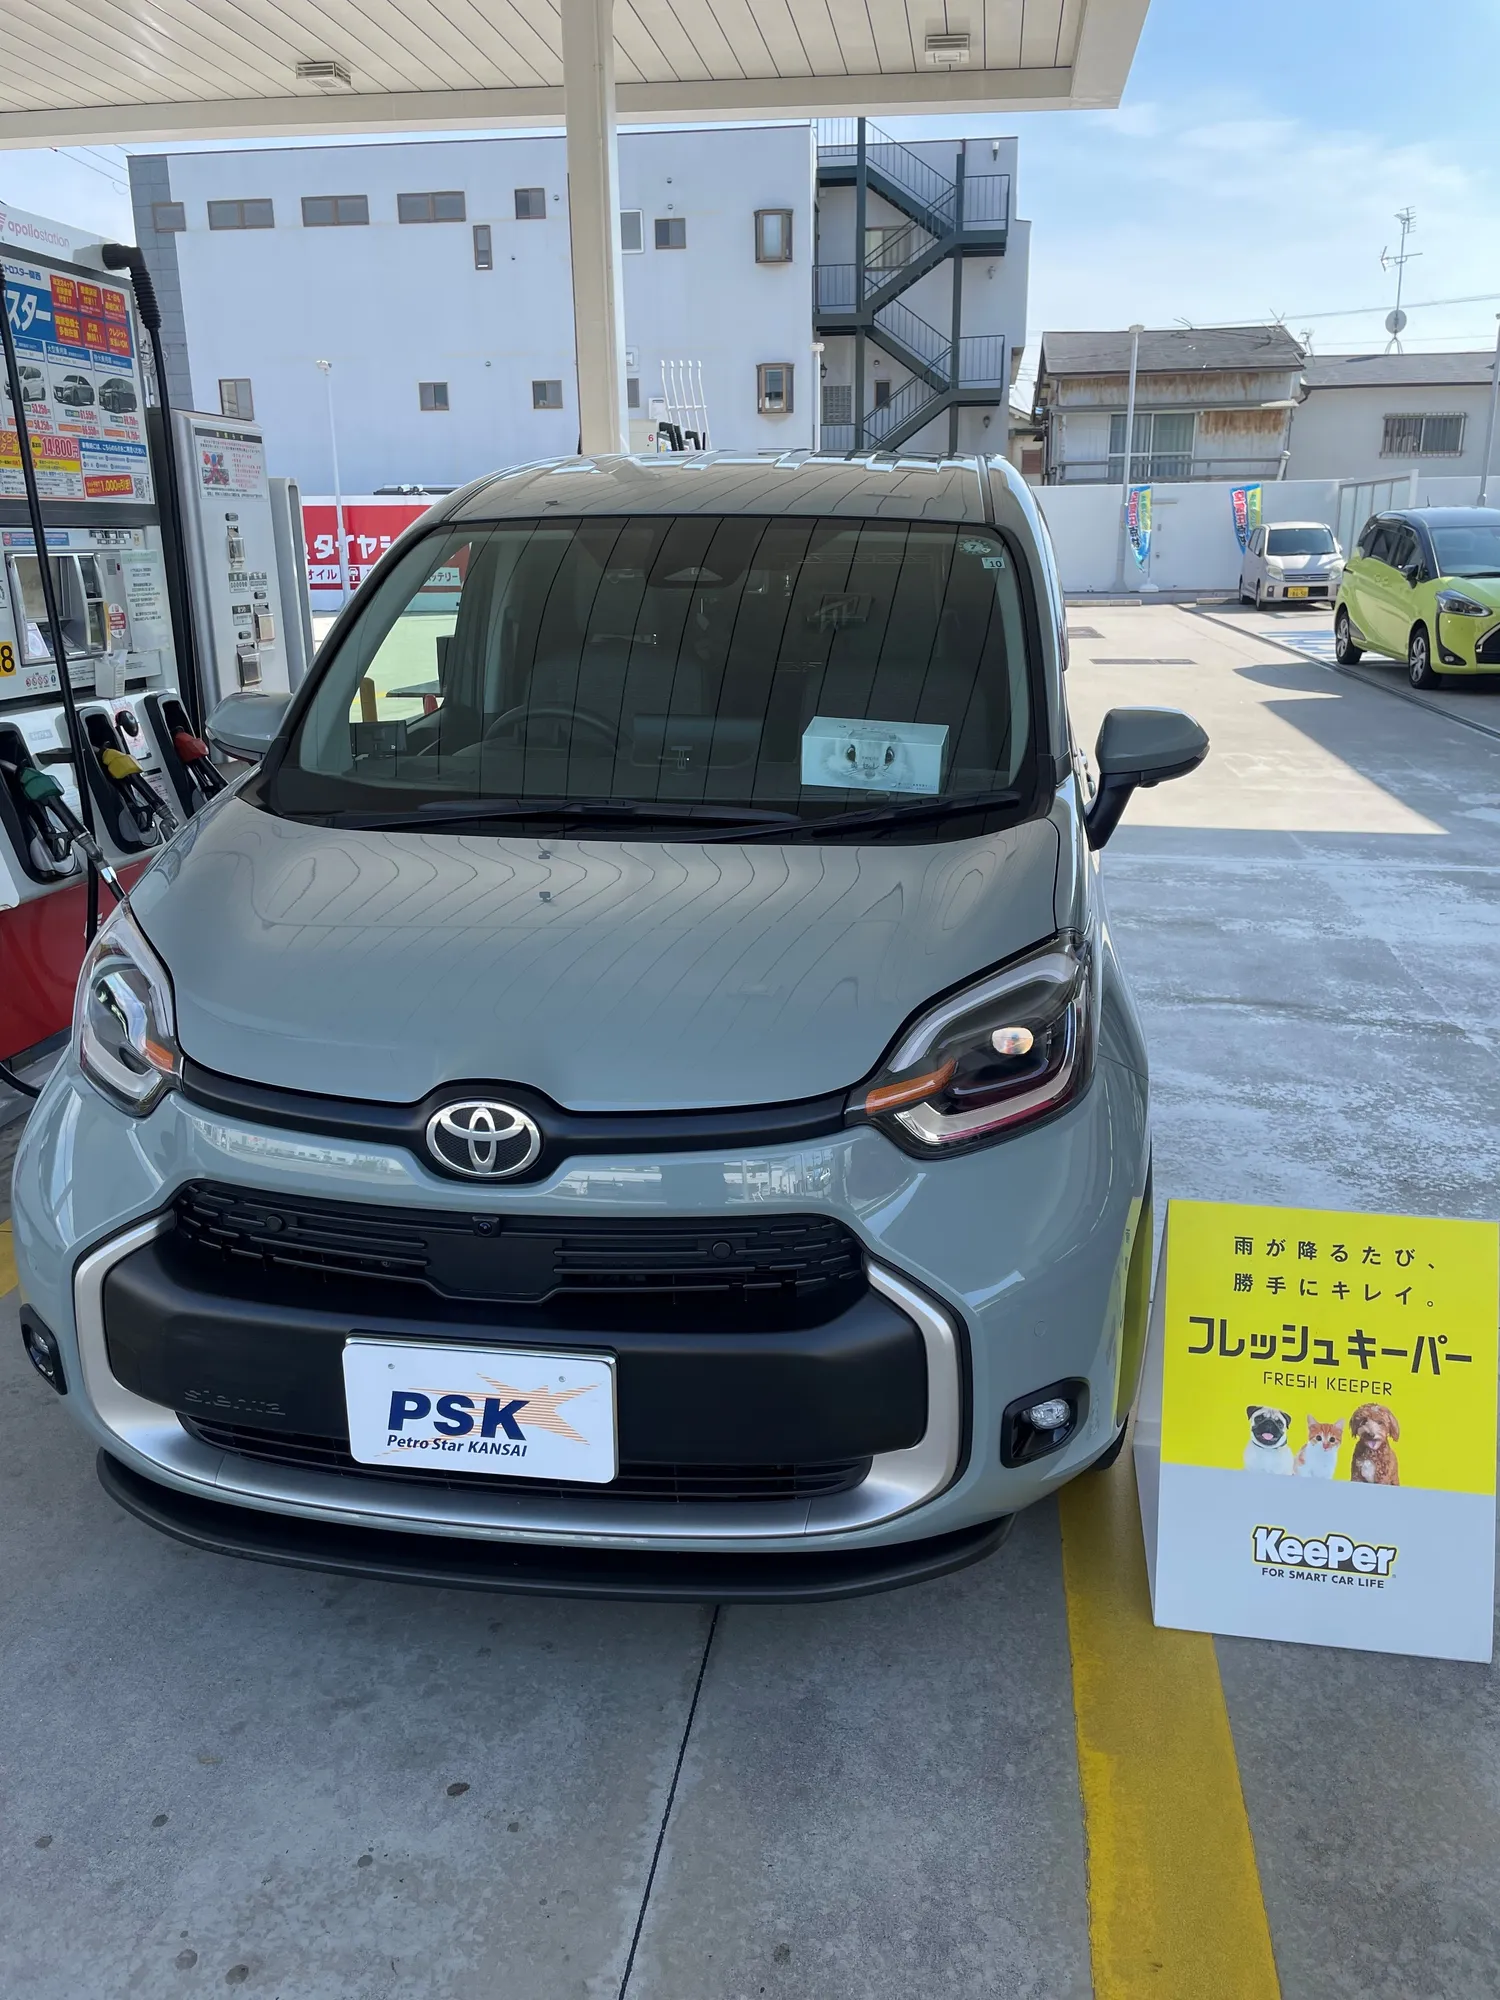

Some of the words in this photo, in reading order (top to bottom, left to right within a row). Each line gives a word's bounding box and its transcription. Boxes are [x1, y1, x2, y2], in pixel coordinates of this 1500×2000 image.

[8, 220, 70, 248] apollostation
[648, 433, 654, 442] 6
[990, 560, 1002, 568] 10
[1234, 1236, 1435, 1269] 雨が降るたび、
[1233, 1273, 1434, 1308] 勝手にキレイ。
[1188, 1316, 1472, 1375] フレッシュキーパー
[1263, 1371, 1317, 1389] FRESH
[1327, 1376, 1393, 1396] KEEPER
[387, 1390, 530, 1441] PSK
[387, 1434, 429, 1449] Petro
[431, 1438, 464, 1453] Star
[467, 1441, 527, 1457] KANSAI
[1252, 1525, 1397, 1577] KeePer
[1262, 1567, 1284, 1578] FOR
[1289, 1570, 1327, 1583] SMART
[1332, 1575, 1354, 1586] CAR
[1358, 1578, 1385, 1589] LIFE
